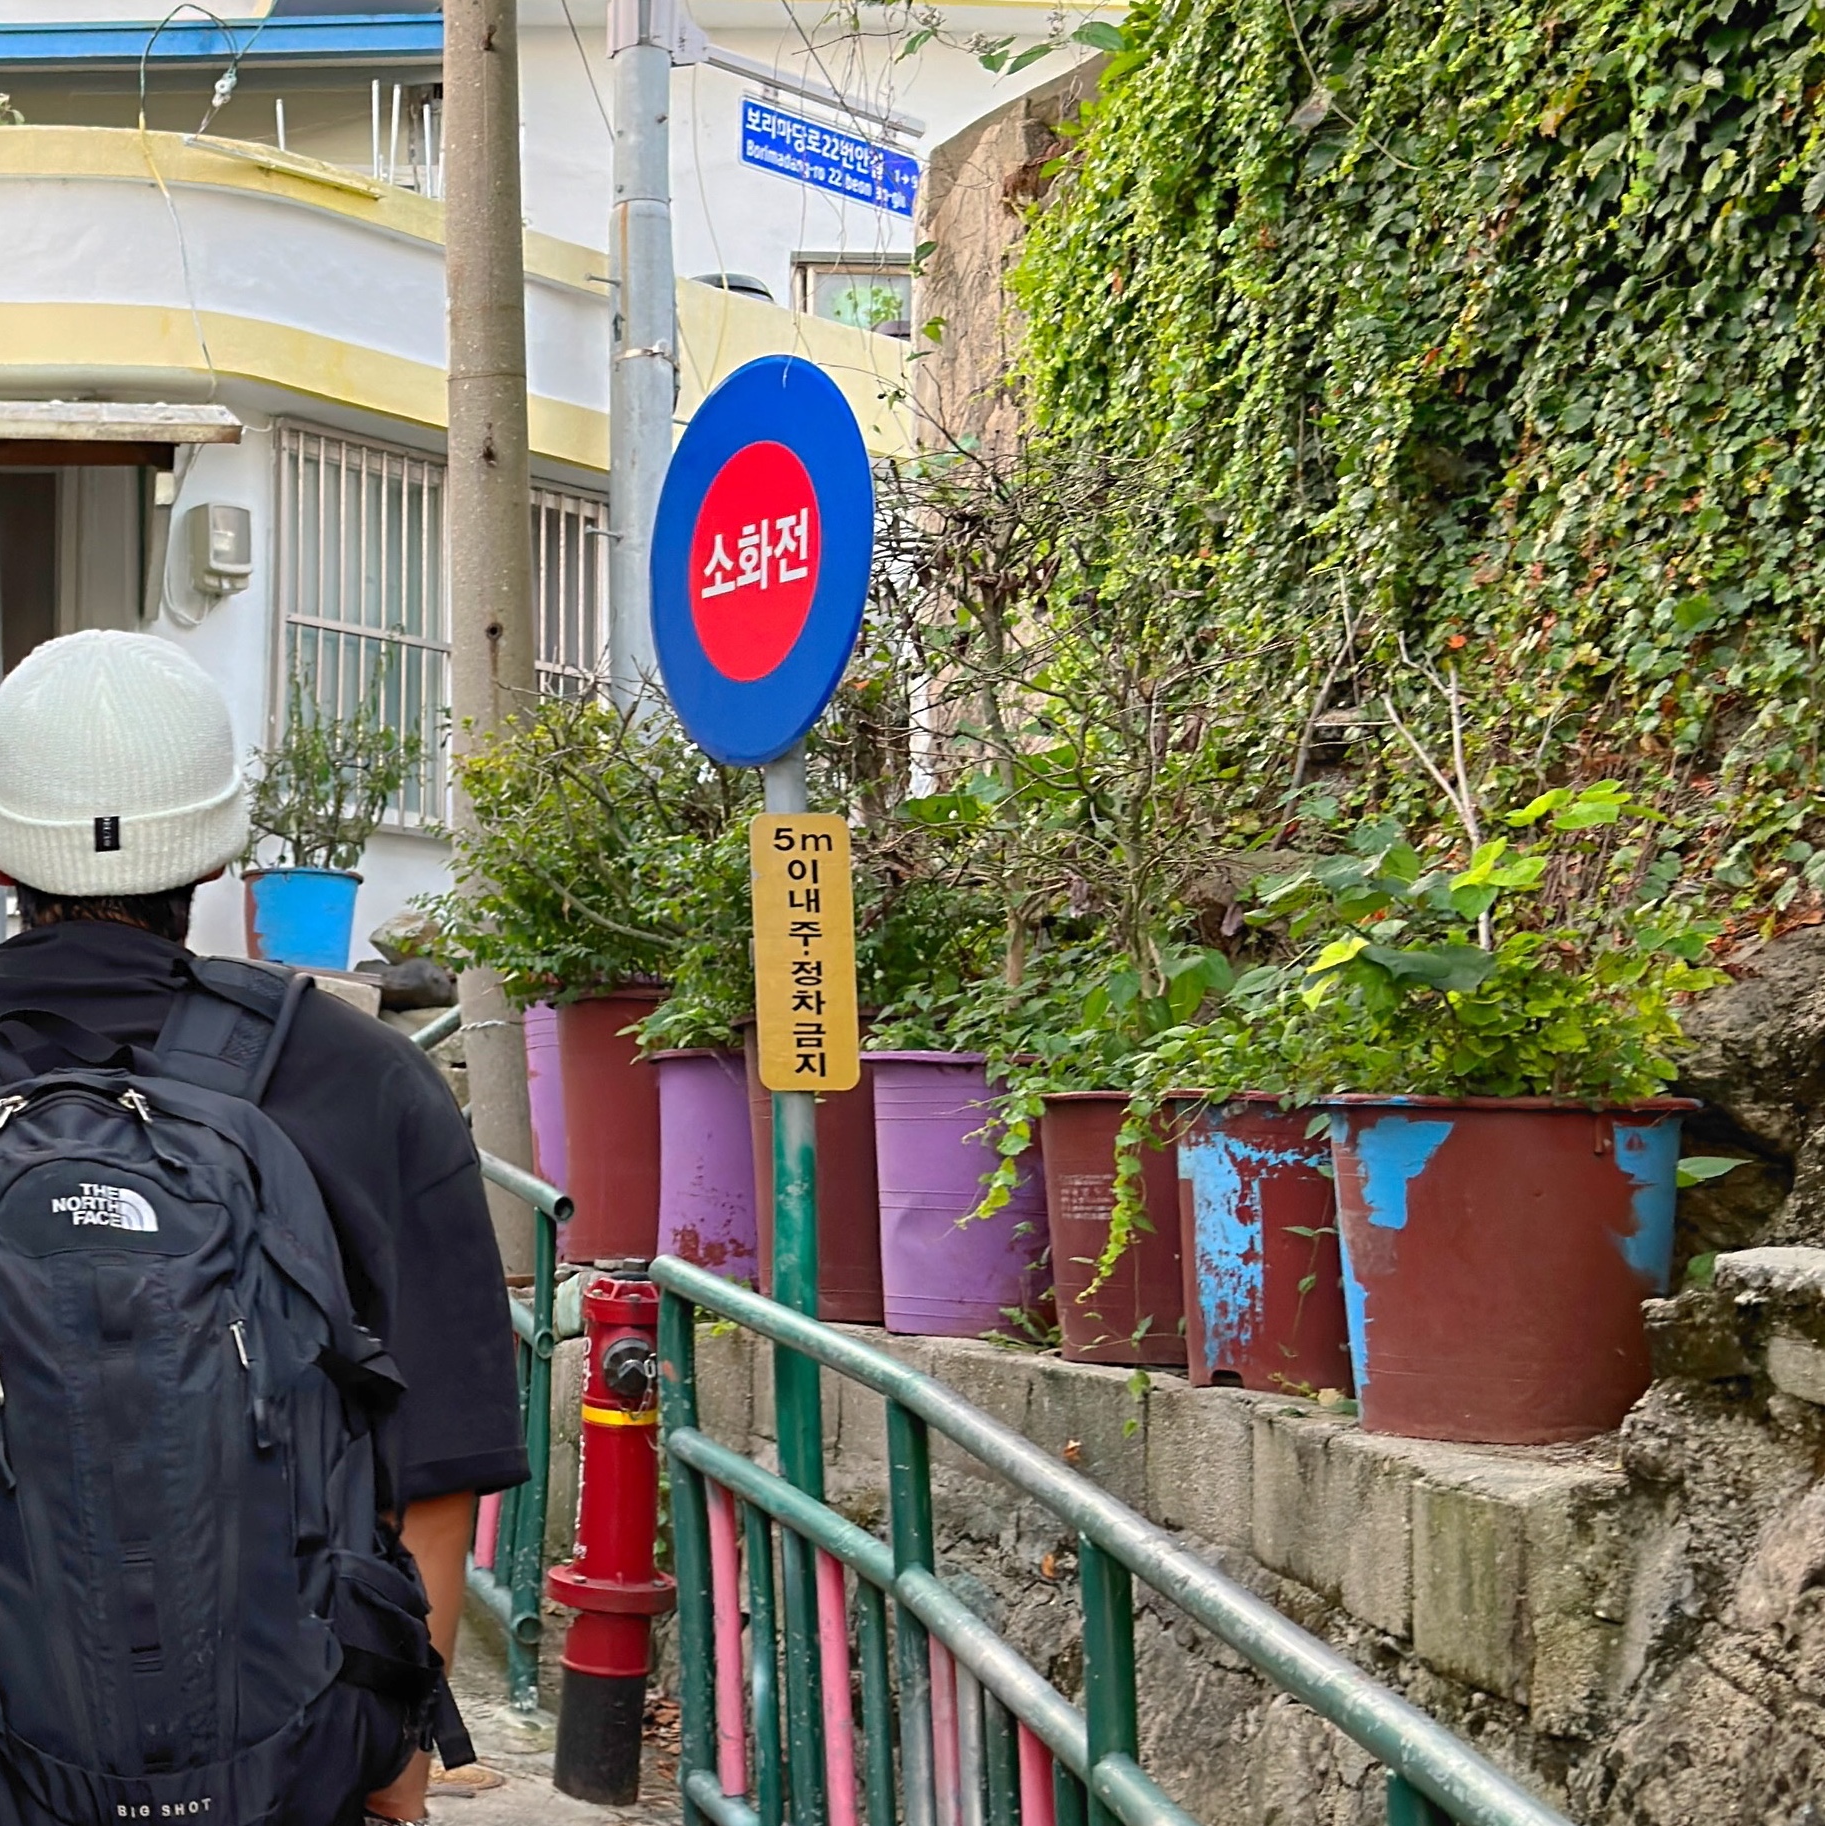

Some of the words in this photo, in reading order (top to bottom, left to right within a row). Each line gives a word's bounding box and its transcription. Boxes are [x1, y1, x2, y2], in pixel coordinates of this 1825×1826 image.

[827, 166, 843, 187] 22
[845, 173, 873, 197] beon
[700, 507, 810, 600] 소화전
[772, 827, 834, 852] 5m
[78, 1182, 120, 1201] THE
[50, 1195, 121, 1214] NORTH
[72, 1210, 123, 1229] FACE
[116, 1804, 151, 1819] BIG
[160, 1797, 212, 1818] SHOT
